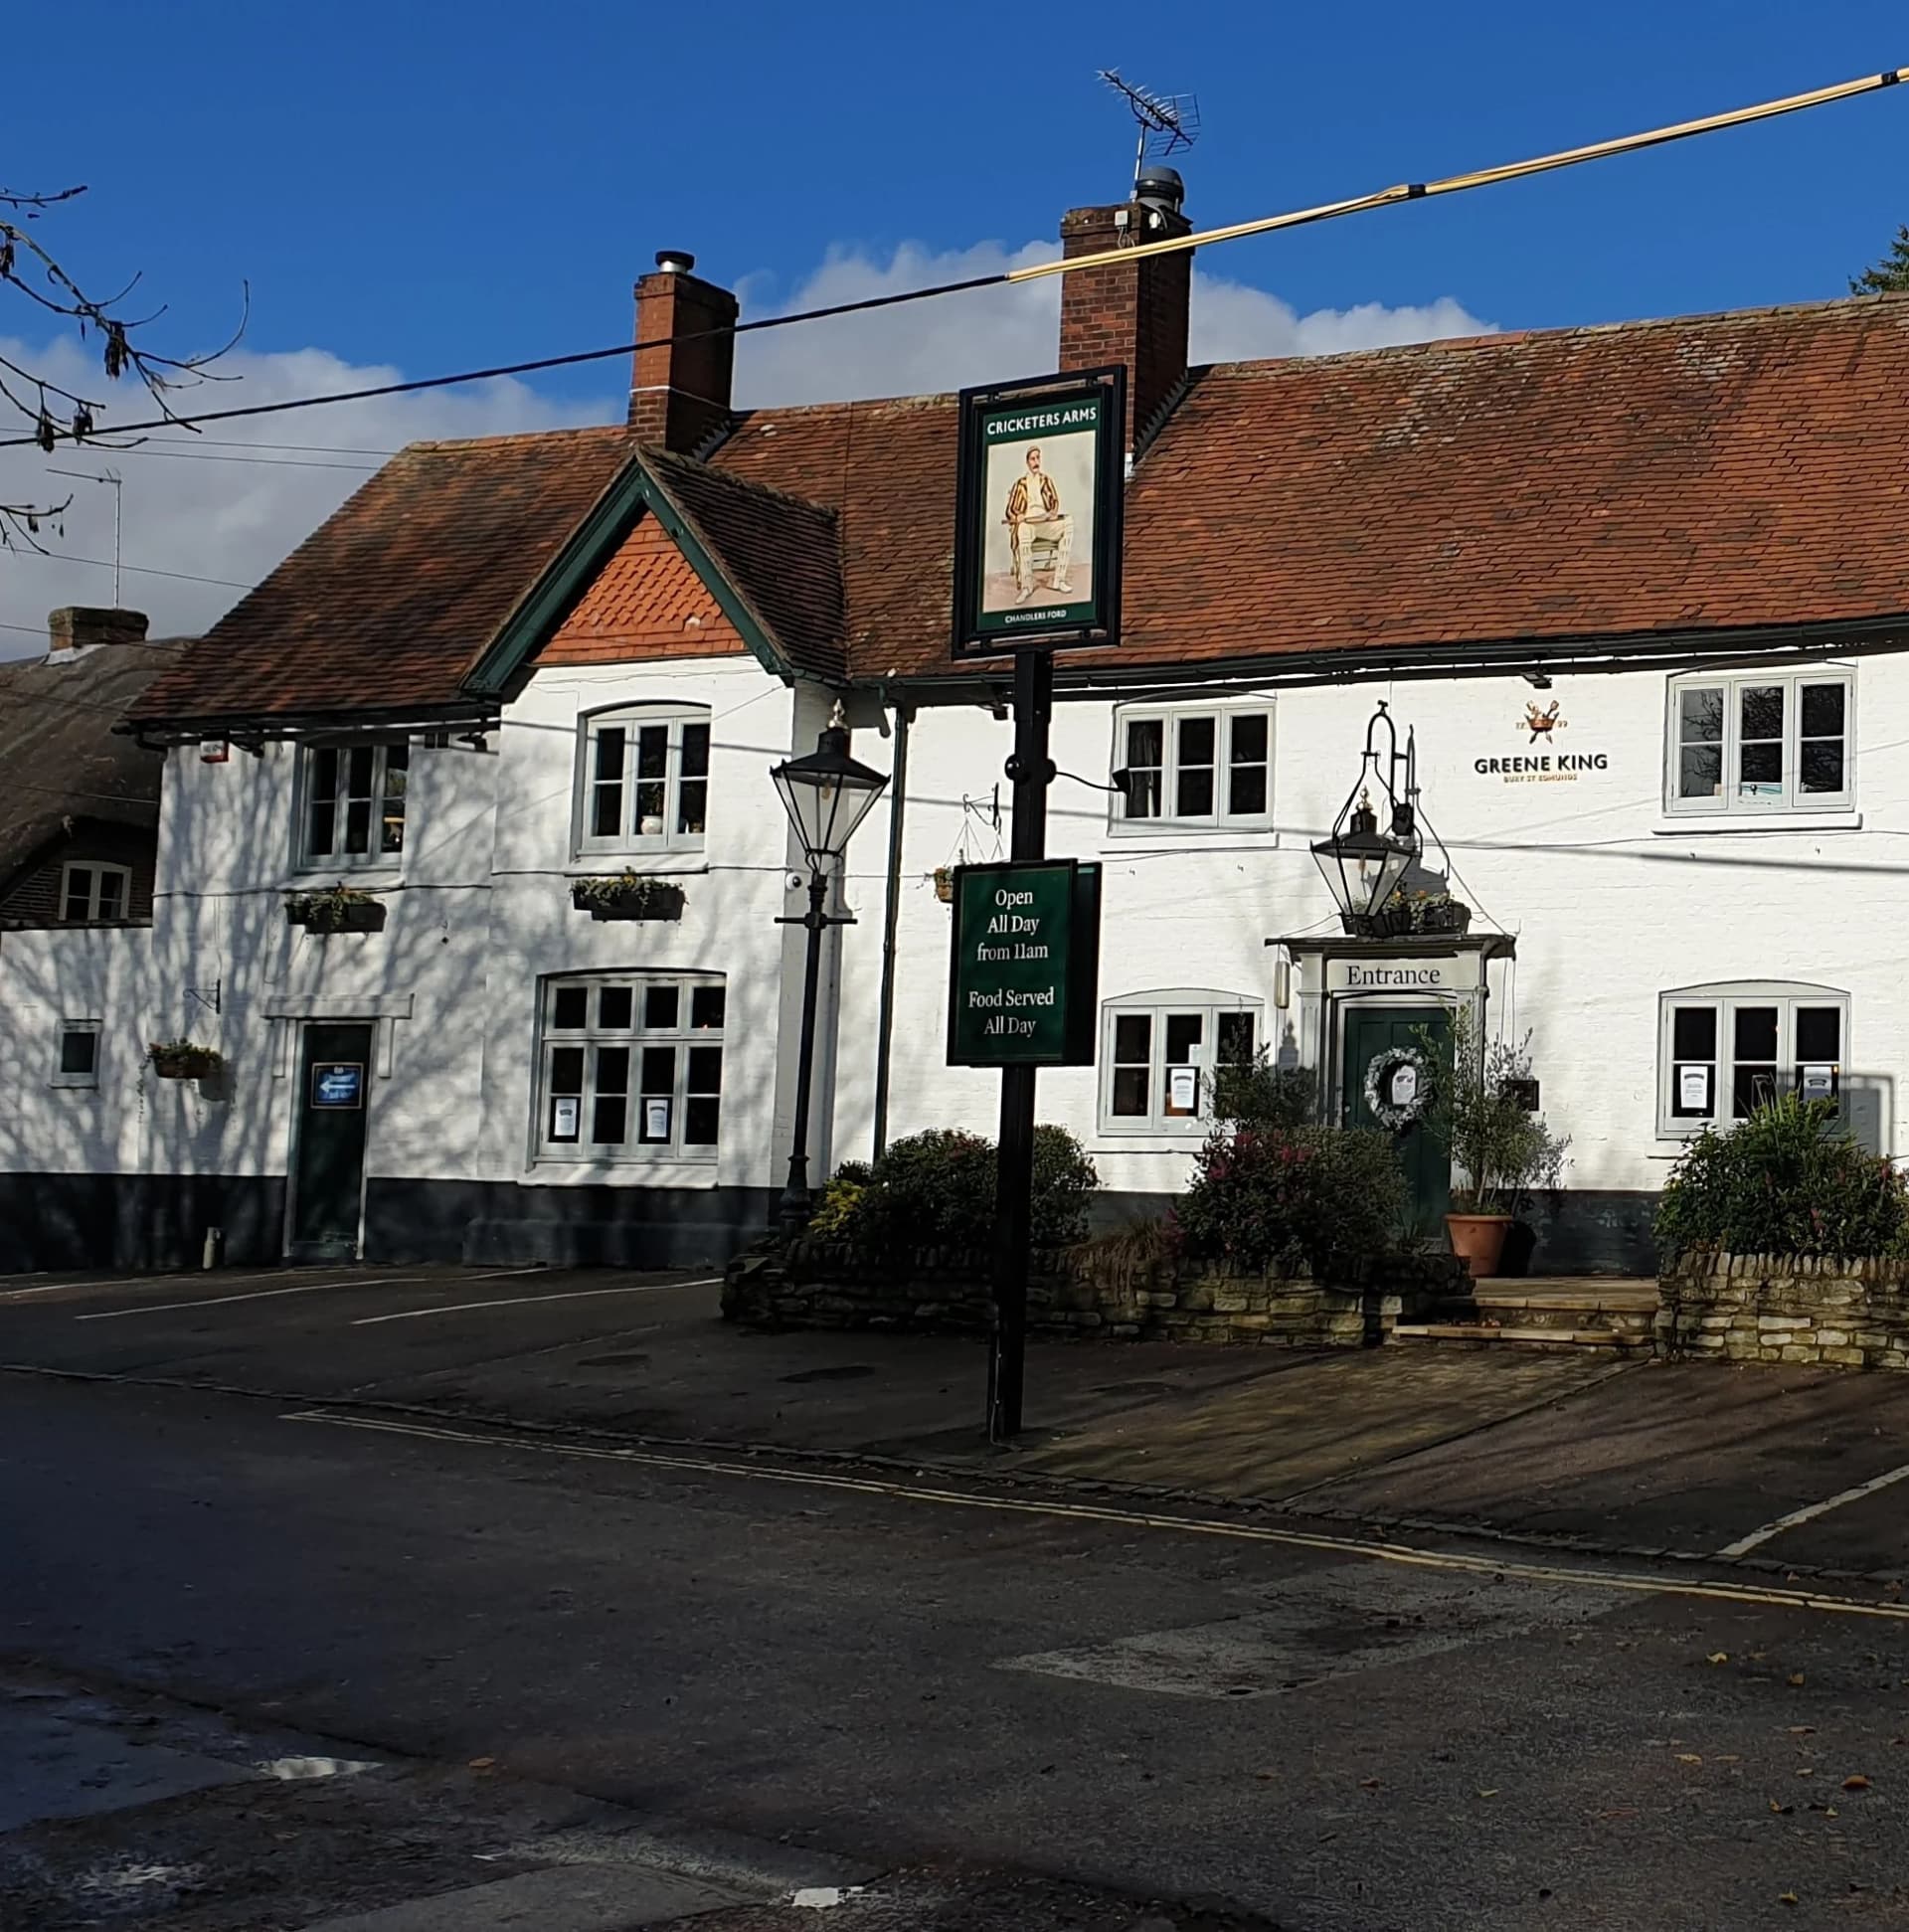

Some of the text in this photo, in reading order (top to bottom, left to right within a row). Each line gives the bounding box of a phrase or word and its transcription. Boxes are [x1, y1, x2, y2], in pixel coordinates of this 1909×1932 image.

[987, 407, 1097, 435] CRICKETERS ARMS
[1047, 610, 1067, 618] FORD
[1475, 754, 1608, 775] GREENE KING
[995, 889, 1034, 910] Open
[987, 914, 1040, 936] All Day
[976, 942, 1049, 962] from 11am
[1346, 965, 1441, 985] Entrance
[968, 986, 1055, 1008] Food Served
[983, 1015, 1037, 1037] All Day
